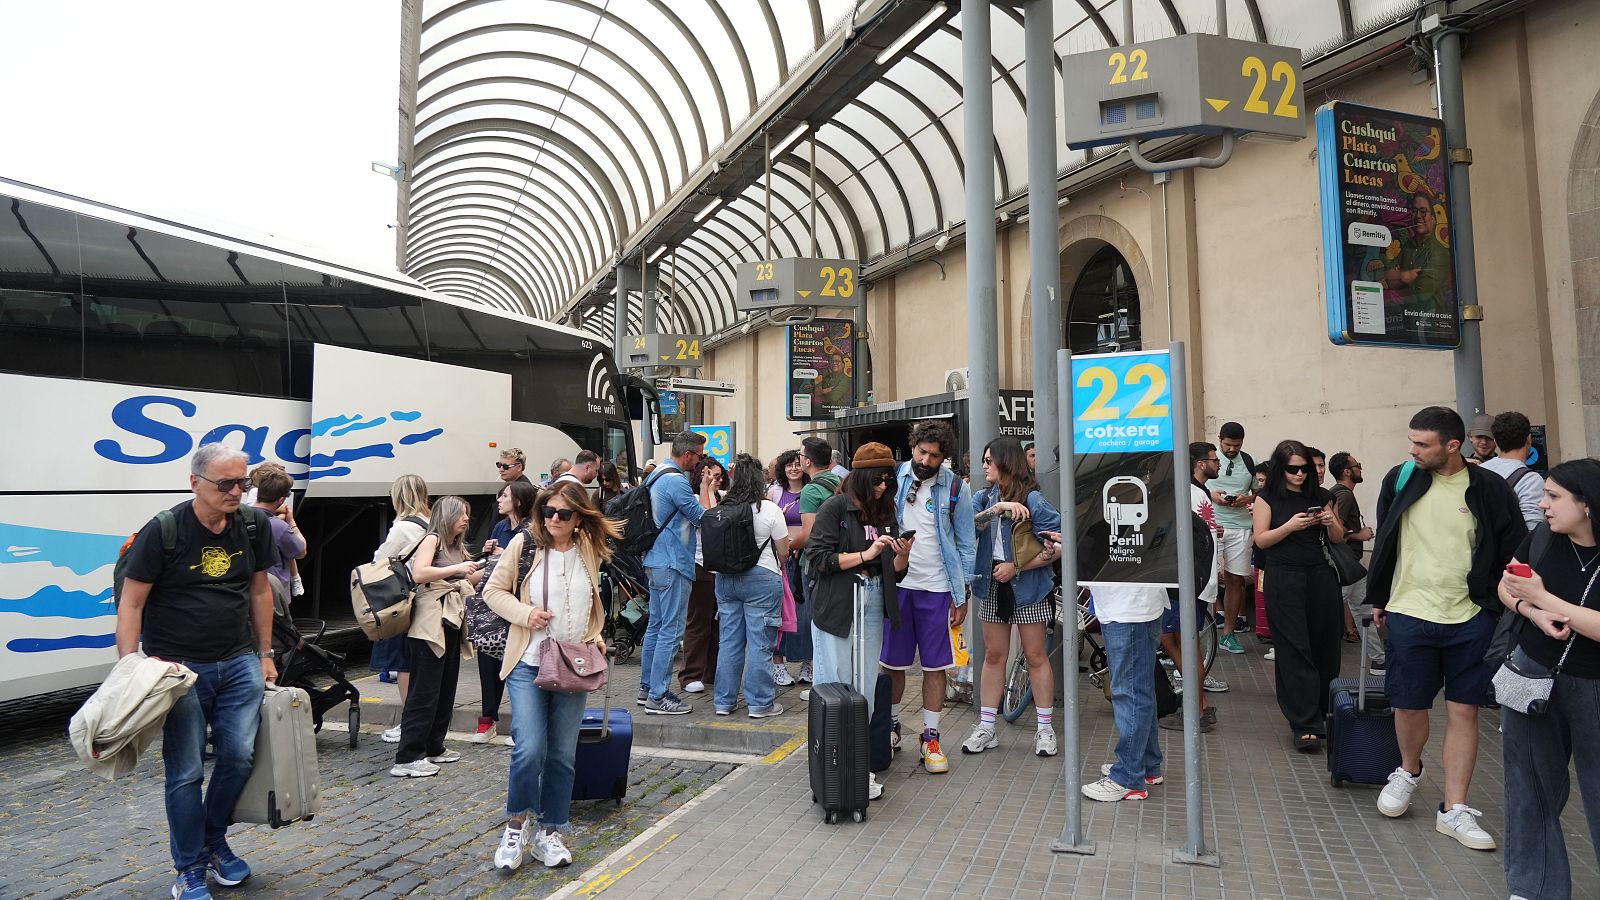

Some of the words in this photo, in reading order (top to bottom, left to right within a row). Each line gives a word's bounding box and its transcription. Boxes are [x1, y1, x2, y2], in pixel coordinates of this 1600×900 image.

[1108, 48, 1149, 85] 22
[1241, 56, 1298, 119] 22
[1341, 119, 1397, 143] Cushqui
[1342, 135, 1377, 154] Plata
[1343, 152, 1397, 173] Cuartos
[1344, 169, 1384, 188] Lucas
[1362, 230, 1386, 241] Remitly
[756, 262, 774, 281] 23
[820, 266, 854, 298] 23
[793, 331, 813, 339] Plata
[793, 338, 824, 346] Cuartos
[581, 340, 593, 350] 623
[634, 337, 646, 350] 24
[675, 339, 700, 360] 24
[1077, 363, 1169, 420] 22
[587, 402, 602, 413] free
[604, 404, 616, 415] wifi
[999, 396, 1034, 421] AFE
[1000, 426, 1034, 435] AFETERÍA
[1084, 424, 1160, 438] cotxera
[1099, 439, 1126, 447] cochera
[1134, 439, 1160, 447] garage
[1109, 533, 1144, 546] Perill
[1109, 547, 1135, 556] Peligro
[1109, 555, 1142, 564] Warning
